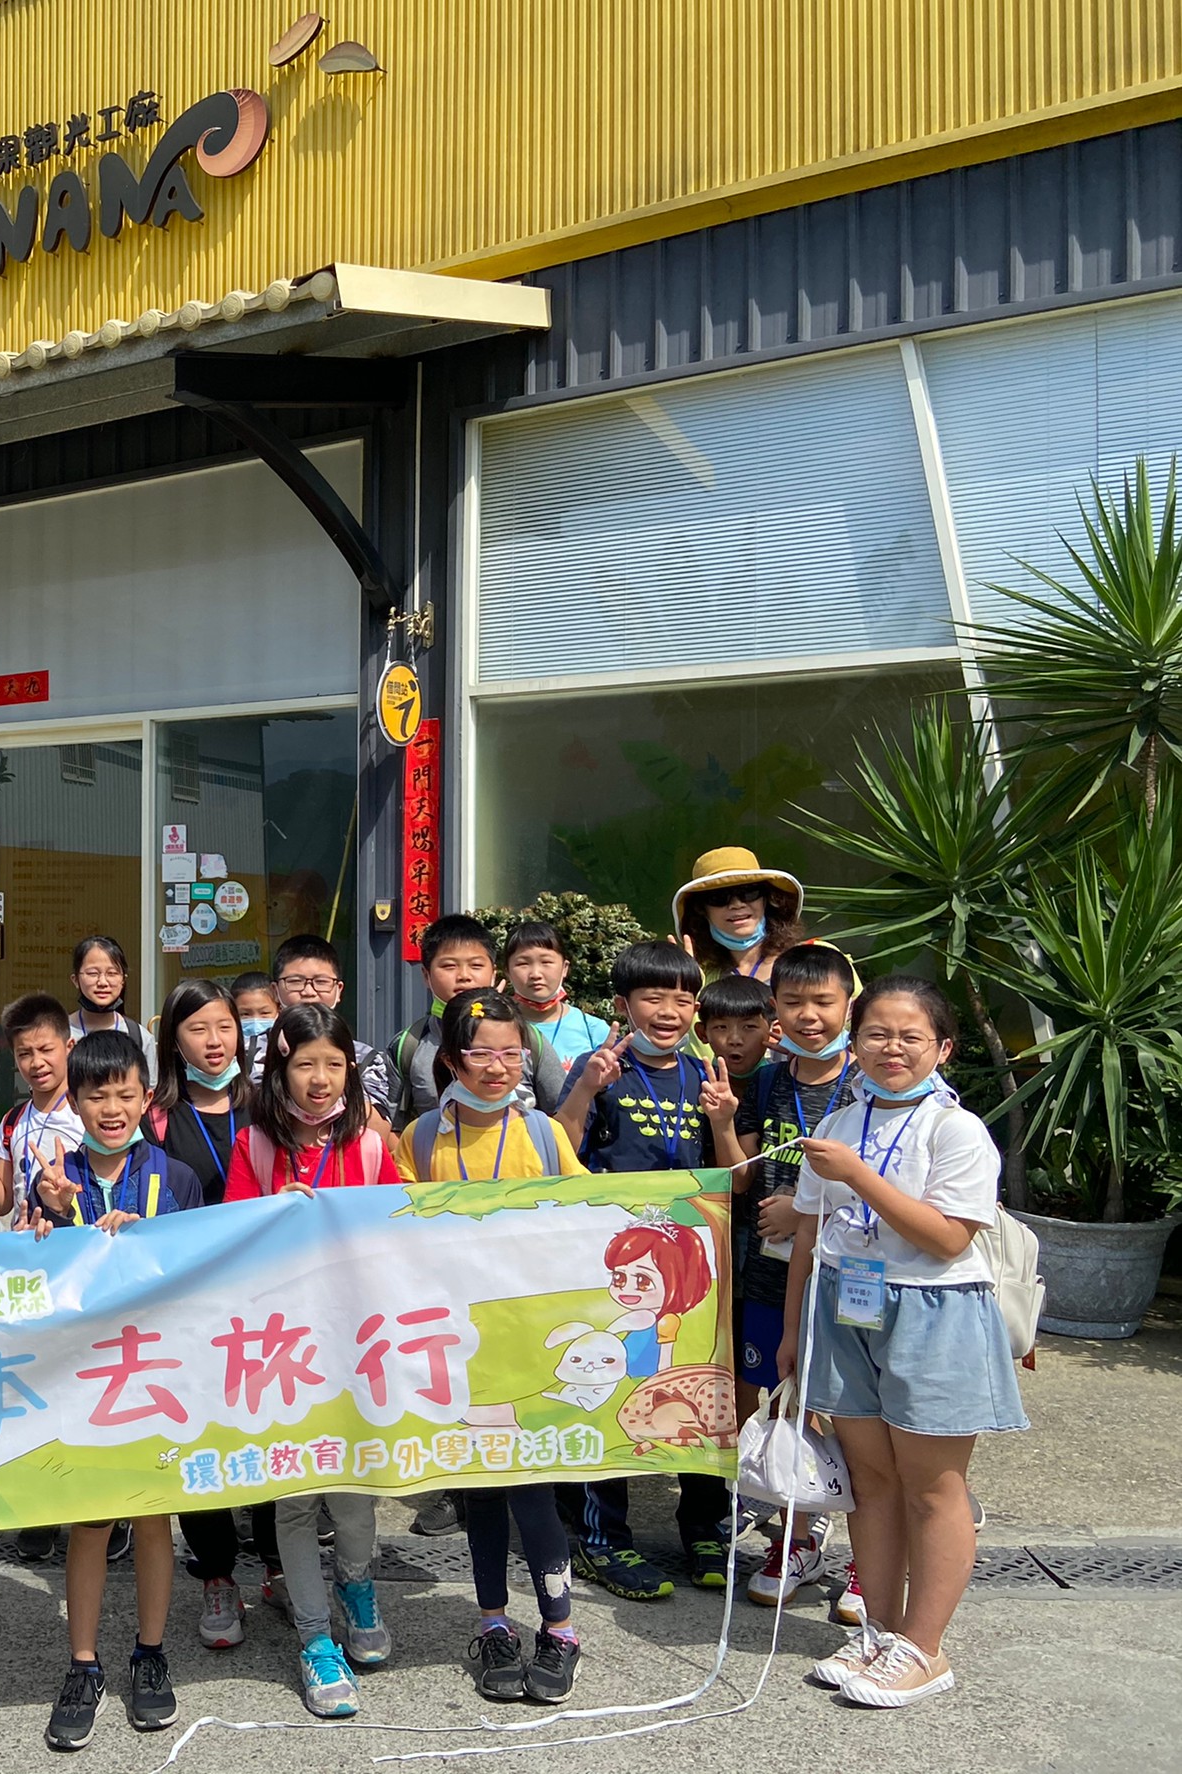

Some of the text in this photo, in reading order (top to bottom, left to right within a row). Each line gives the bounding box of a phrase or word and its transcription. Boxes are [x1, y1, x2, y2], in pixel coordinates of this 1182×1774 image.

[184, 1427, 601, 1493] 環境教育戶外學習活動
